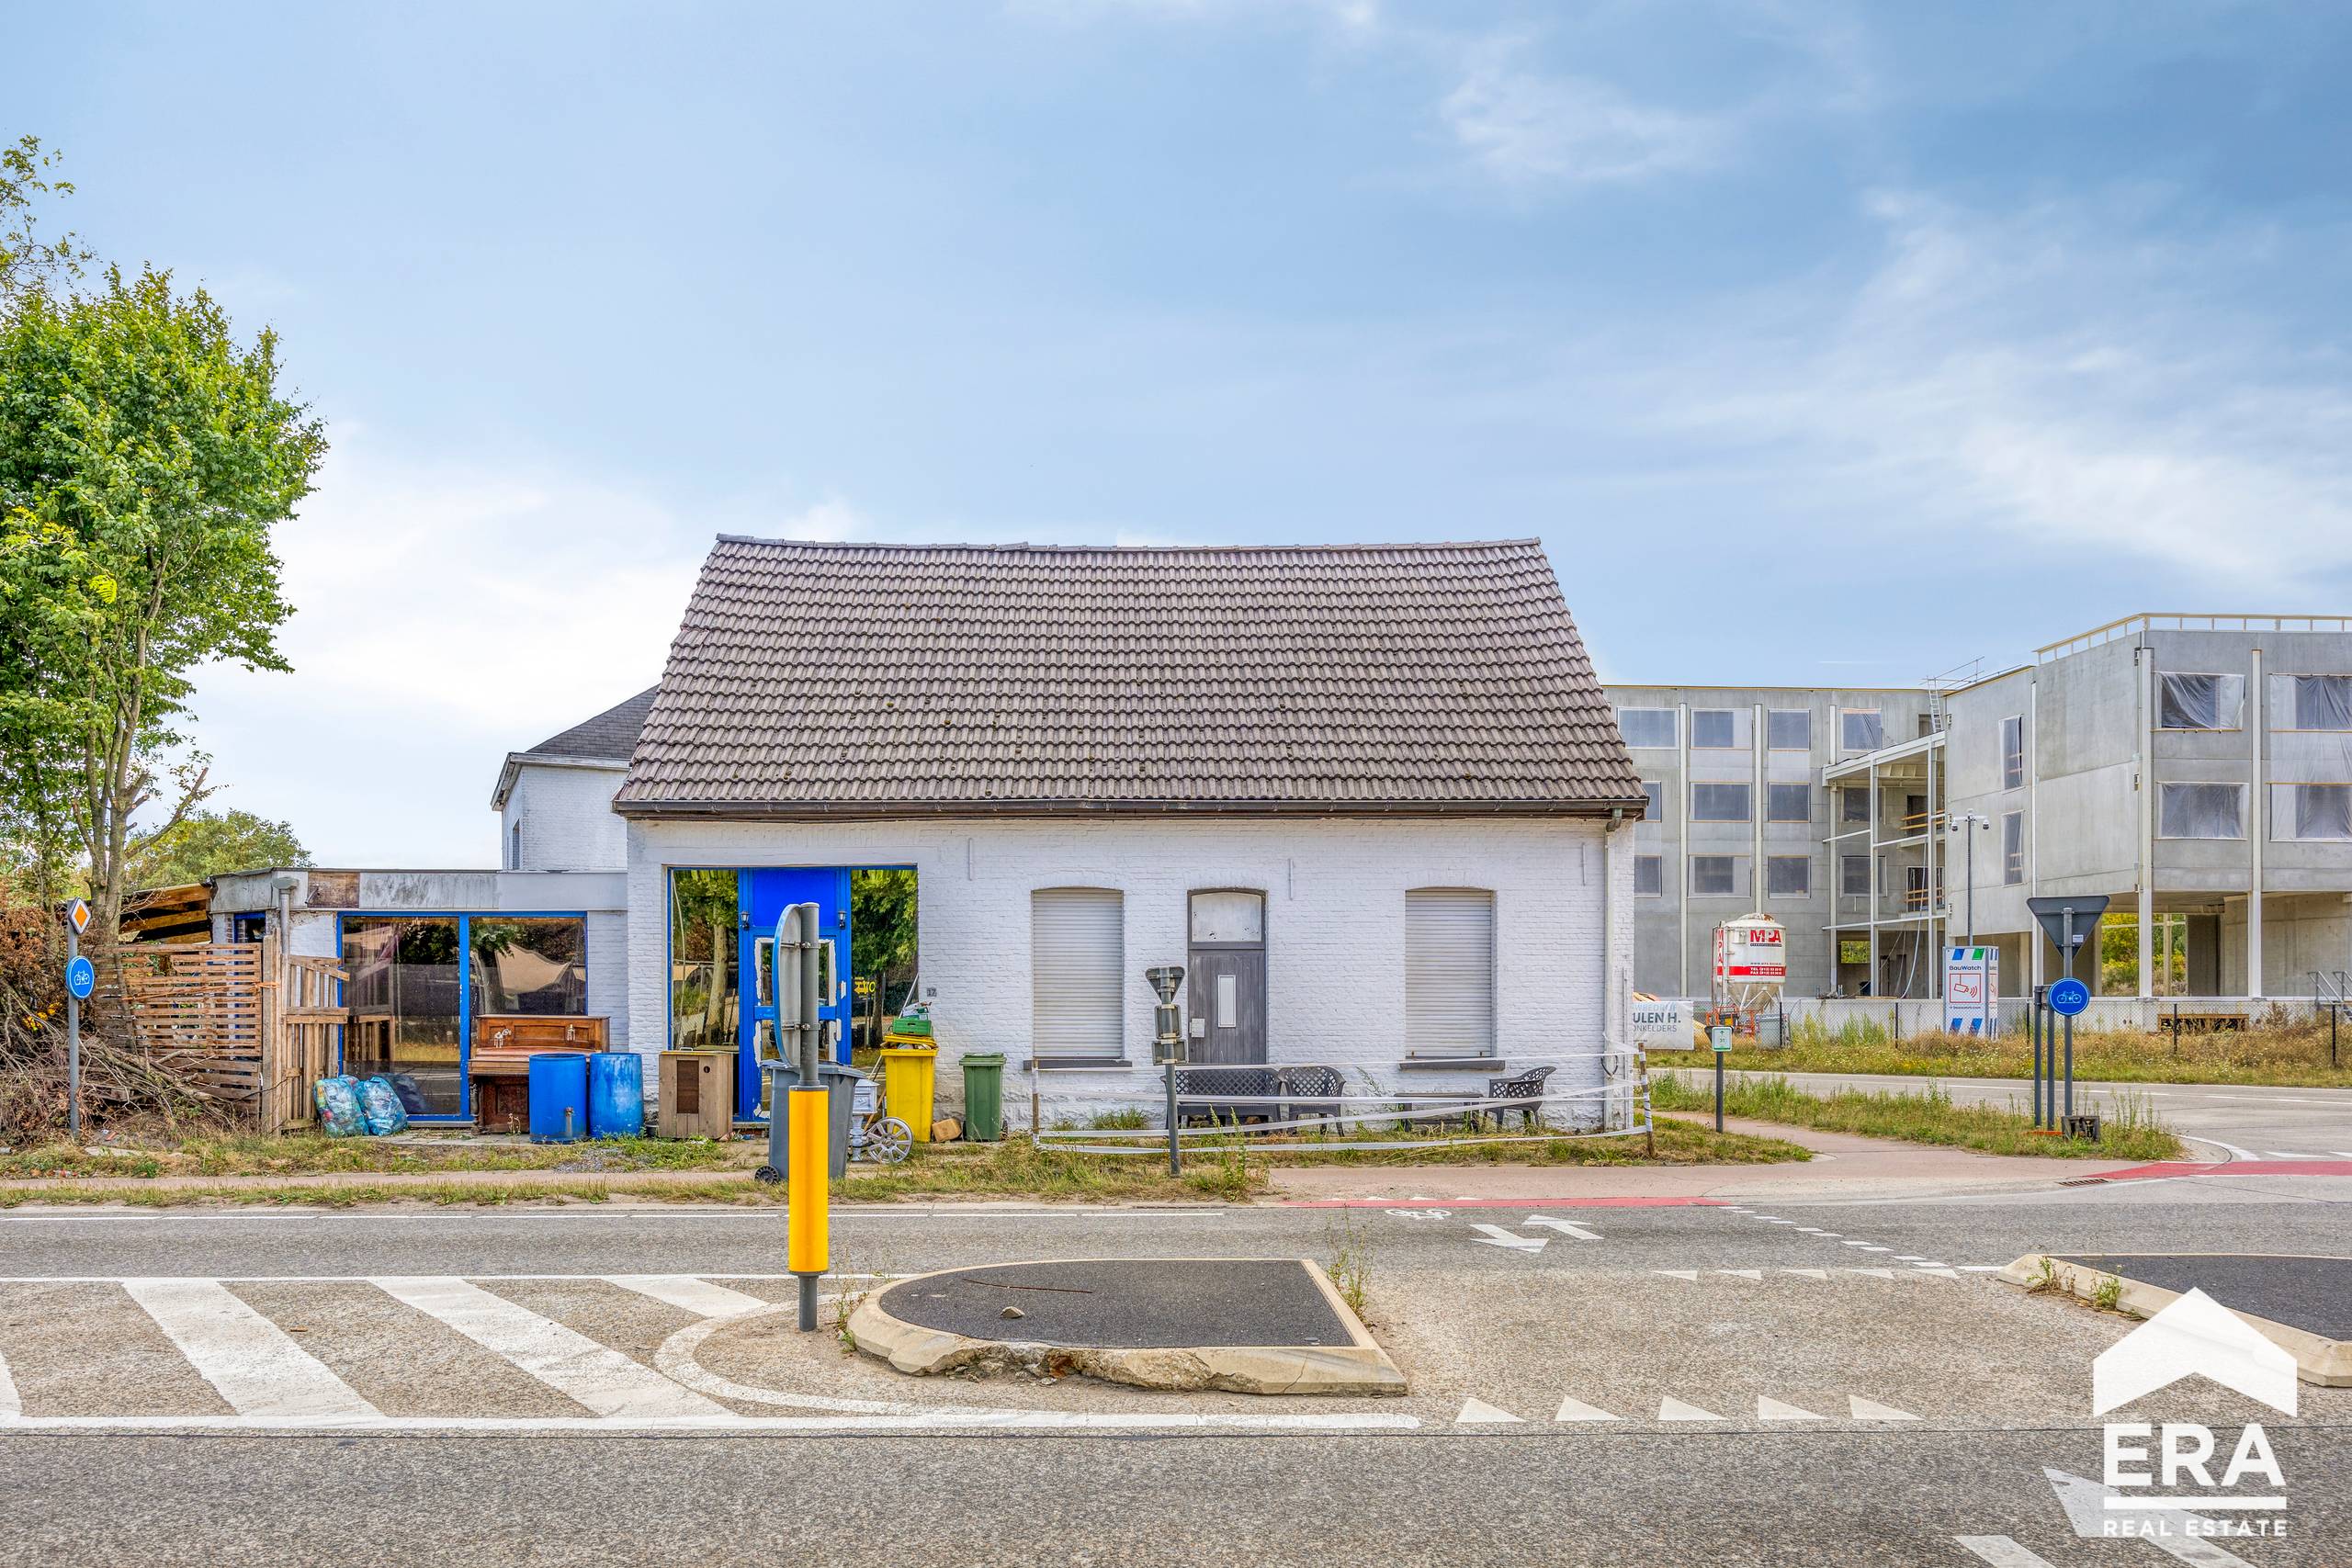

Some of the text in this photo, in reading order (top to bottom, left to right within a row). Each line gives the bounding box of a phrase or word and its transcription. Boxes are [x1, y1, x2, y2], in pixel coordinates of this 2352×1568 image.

[1749, 930, 1781, 942] MPA
[1633, 1012, 1681, 1023] ULEN H.
